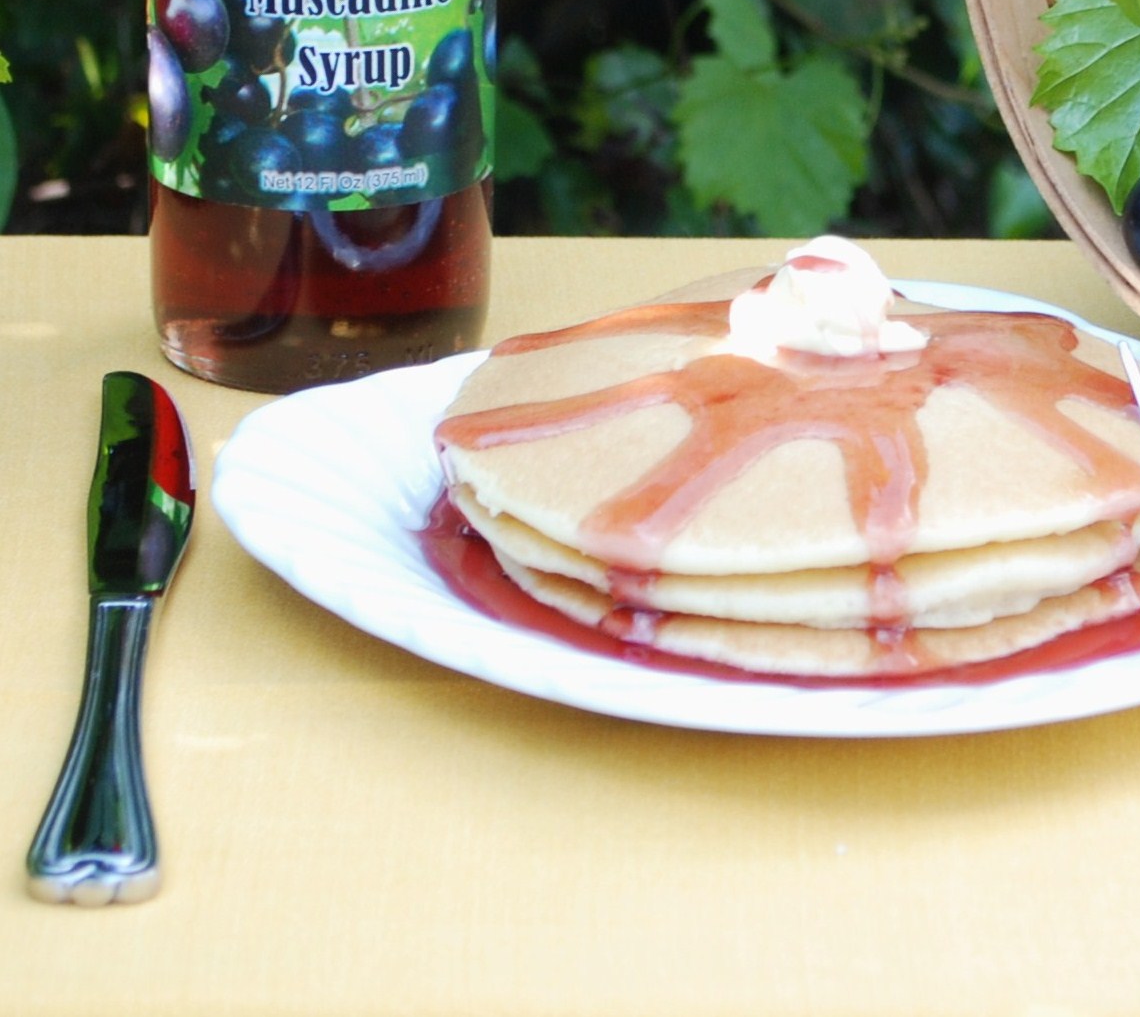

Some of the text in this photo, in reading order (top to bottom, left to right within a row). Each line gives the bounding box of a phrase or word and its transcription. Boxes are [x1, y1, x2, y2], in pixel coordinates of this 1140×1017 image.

[299, 45, 412, 91] Syrup
[262, 172, 291, 191] Net
[297, 173, 316, 190] 12
[340, 173, 361, 189] Oz
[365, 170, 400, 192] (375
[403, 165, 427, 189] ml)
